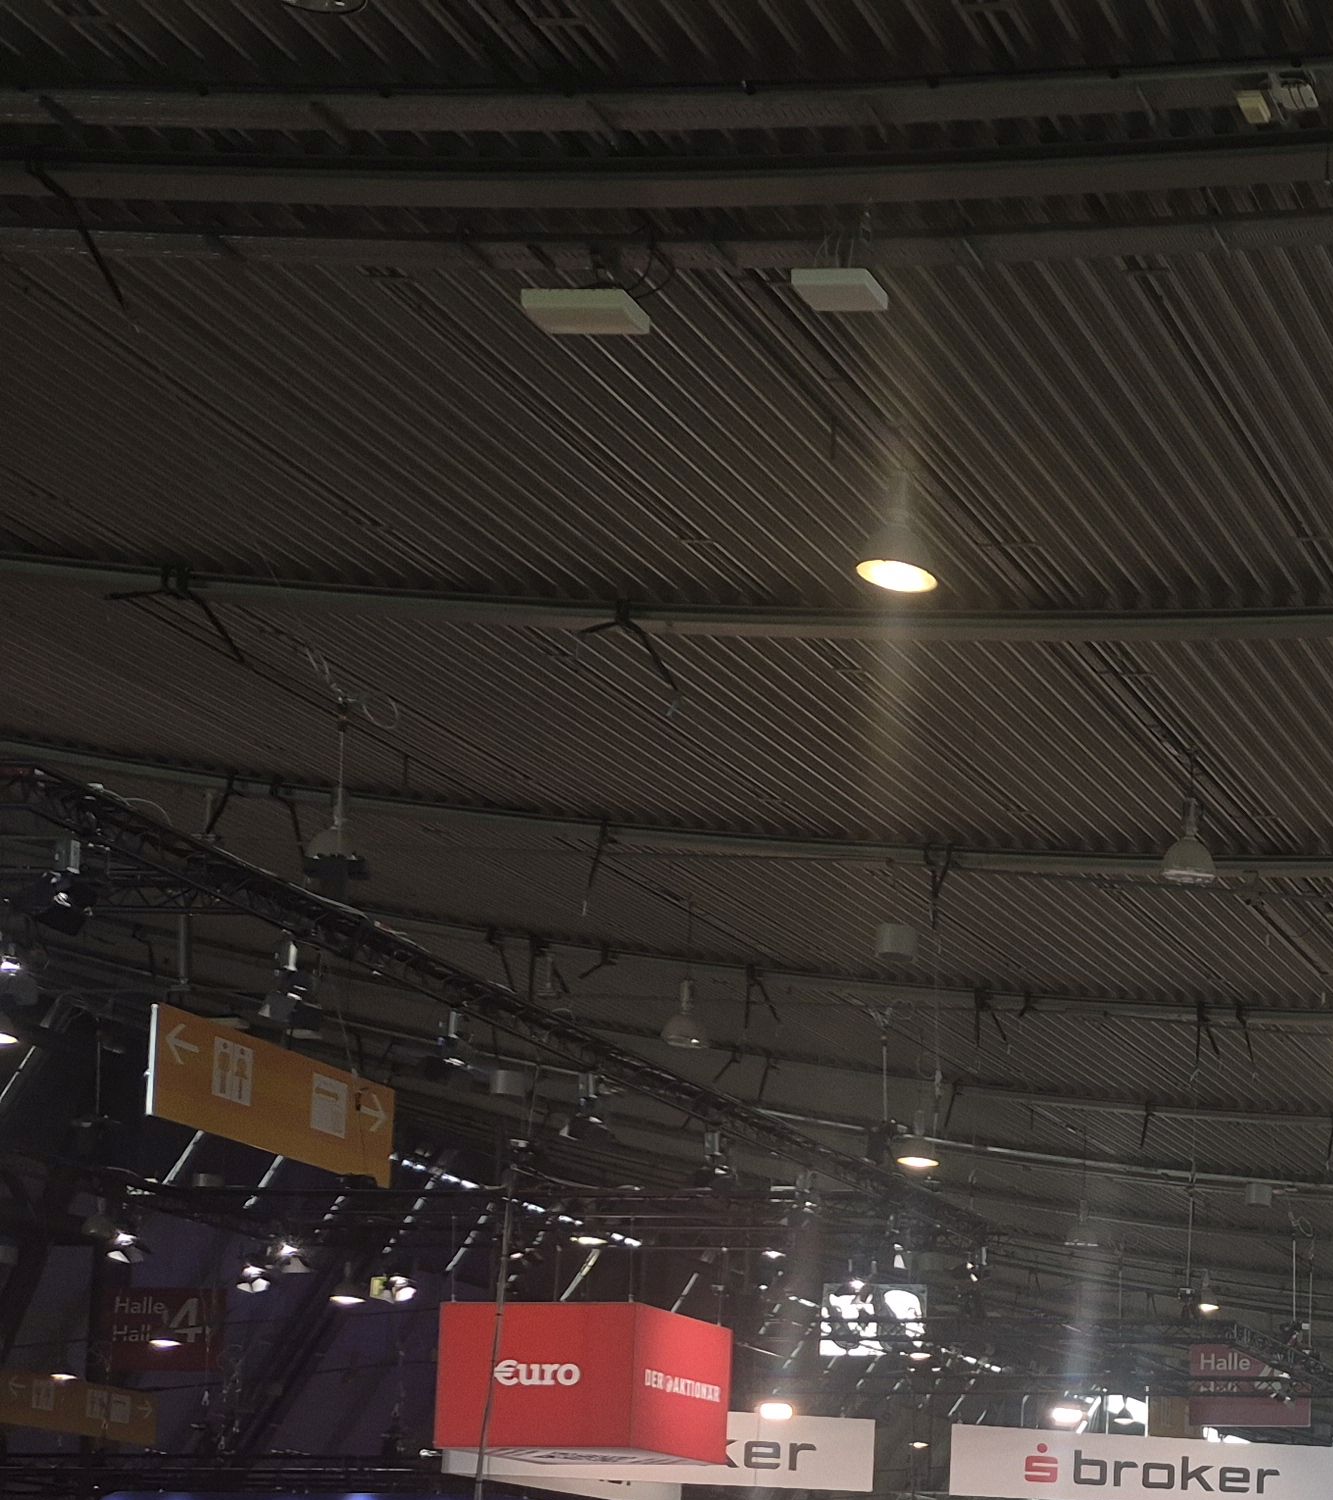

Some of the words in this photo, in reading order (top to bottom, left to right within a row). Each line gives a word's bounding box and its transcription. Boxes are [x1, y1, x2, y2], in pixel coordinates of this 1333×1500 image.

[114, 1296, 165, 1315] Halle
[163, 1298, 203, 1343] 4
[1200, 1352, 1251, 1371] Halle
[644, 1368, 664, 1389] DER
[1074, 1449, 1281, 1495] broker
